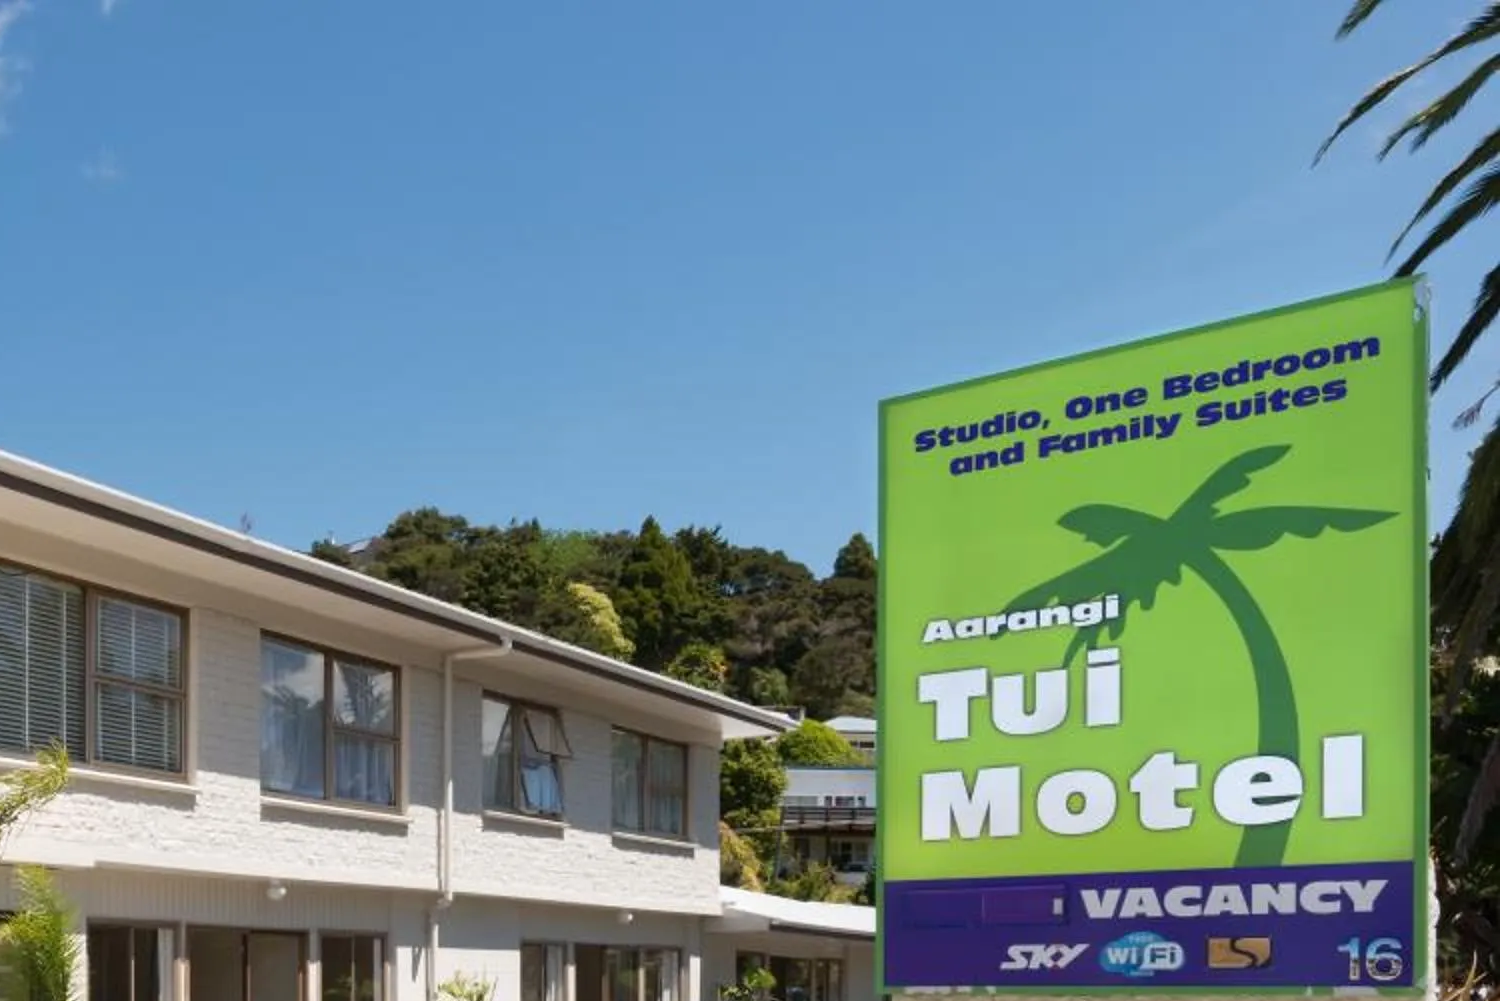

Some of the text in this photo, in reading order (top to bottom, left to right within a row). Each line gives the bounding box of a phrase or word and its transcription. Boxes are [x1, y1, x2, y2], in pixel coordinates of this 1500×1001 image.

[914, 335, 1381, 452] Studio, One Bedroom
[949, 379, 1348, 476] and Family Suites
[922, 594, 1119, 644] Aarangi
[918, 648, 1121, 741] Tui
[921, 734, 1364, 841] Motel
[1080, 880, 1389, 918] VACANCY
[1000, 943, 1090, 970] SKY
[1337, 937, 1403, 980] 16
